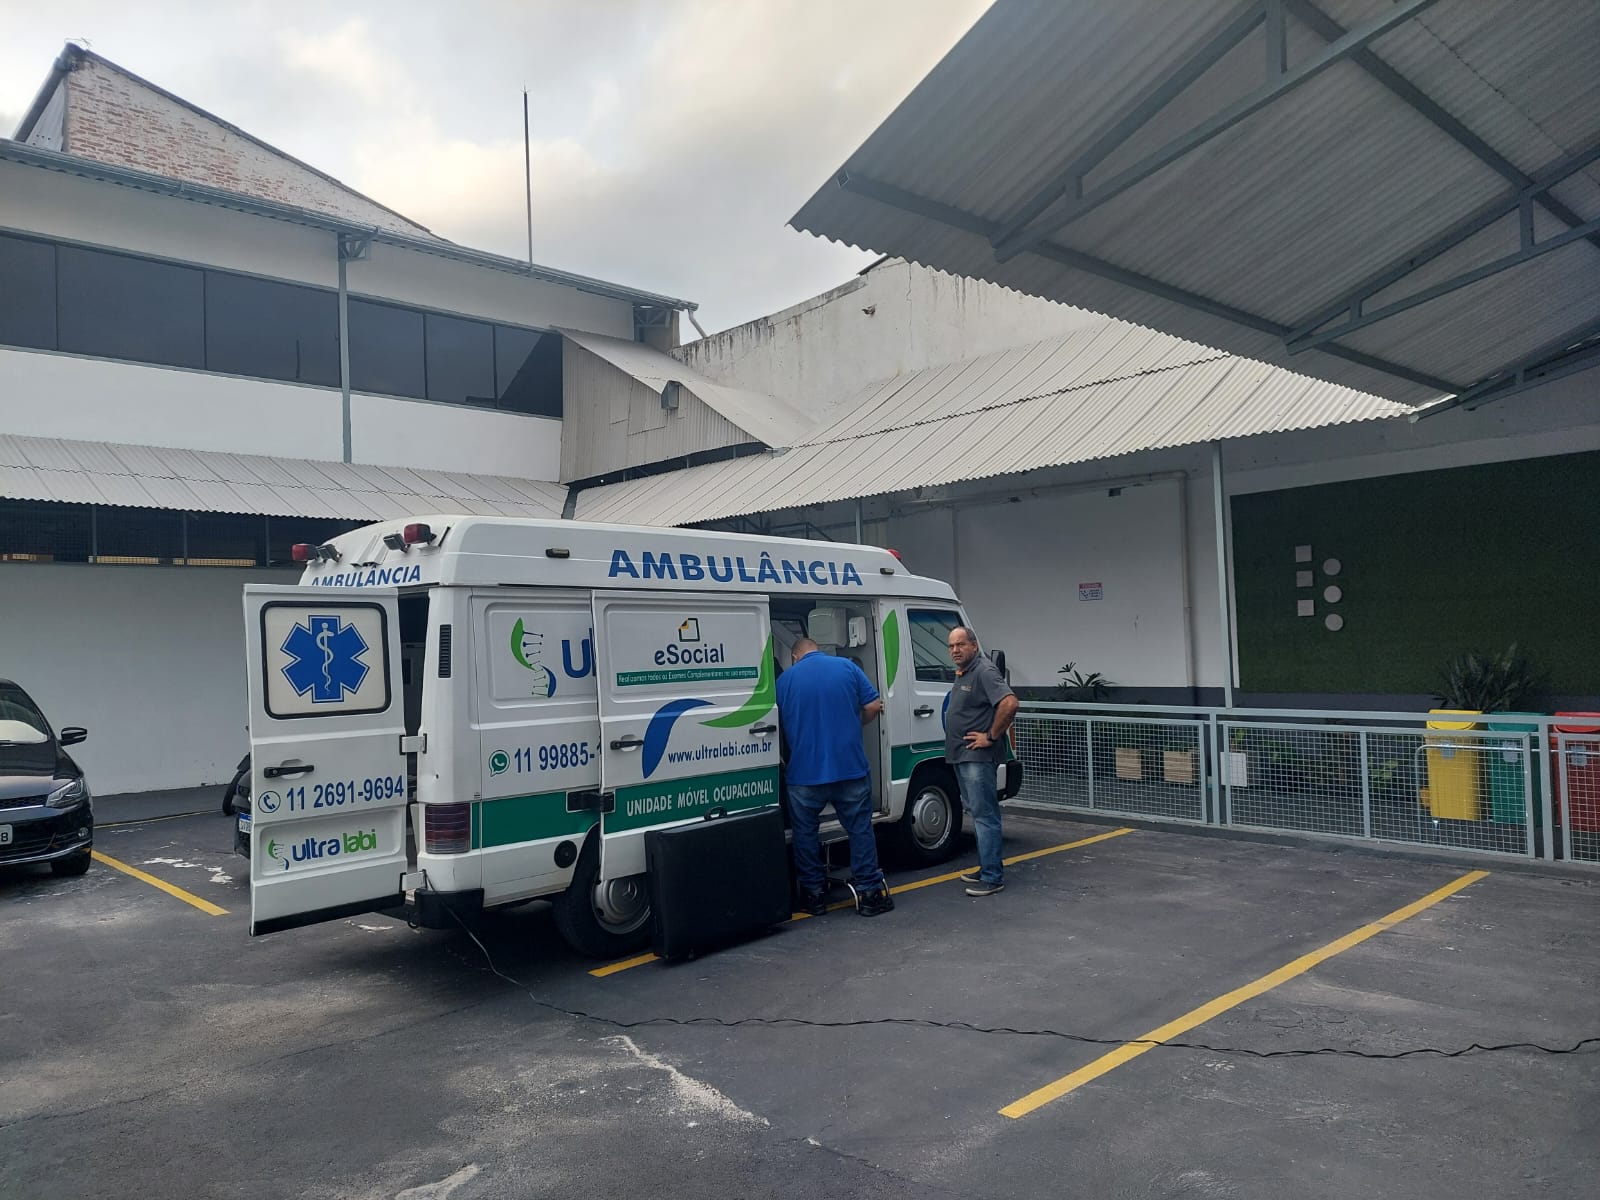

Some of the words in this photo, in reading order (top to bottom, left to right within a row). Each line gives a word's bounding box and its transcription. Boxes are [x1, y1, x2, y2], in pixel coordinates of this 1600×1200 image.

[311, 564, 421, 587] AMBULÂNCIA
[608, 549, 863, 586] AMBULÂNCIA
[654, 643, 725, 665] eSocial
[514, 747, 531, 773] 11
[668, 738, 772, 764] www.ultralabi.com.br
[286, 785, 305, 812] 11
[313, 775, 405, 809] 2691-9694
[626, 794, 672, 817] UNIDADE
[677, 786, 710, 809] MÓVEL
[713, 779, 774, 802] OCUPACIONAL
